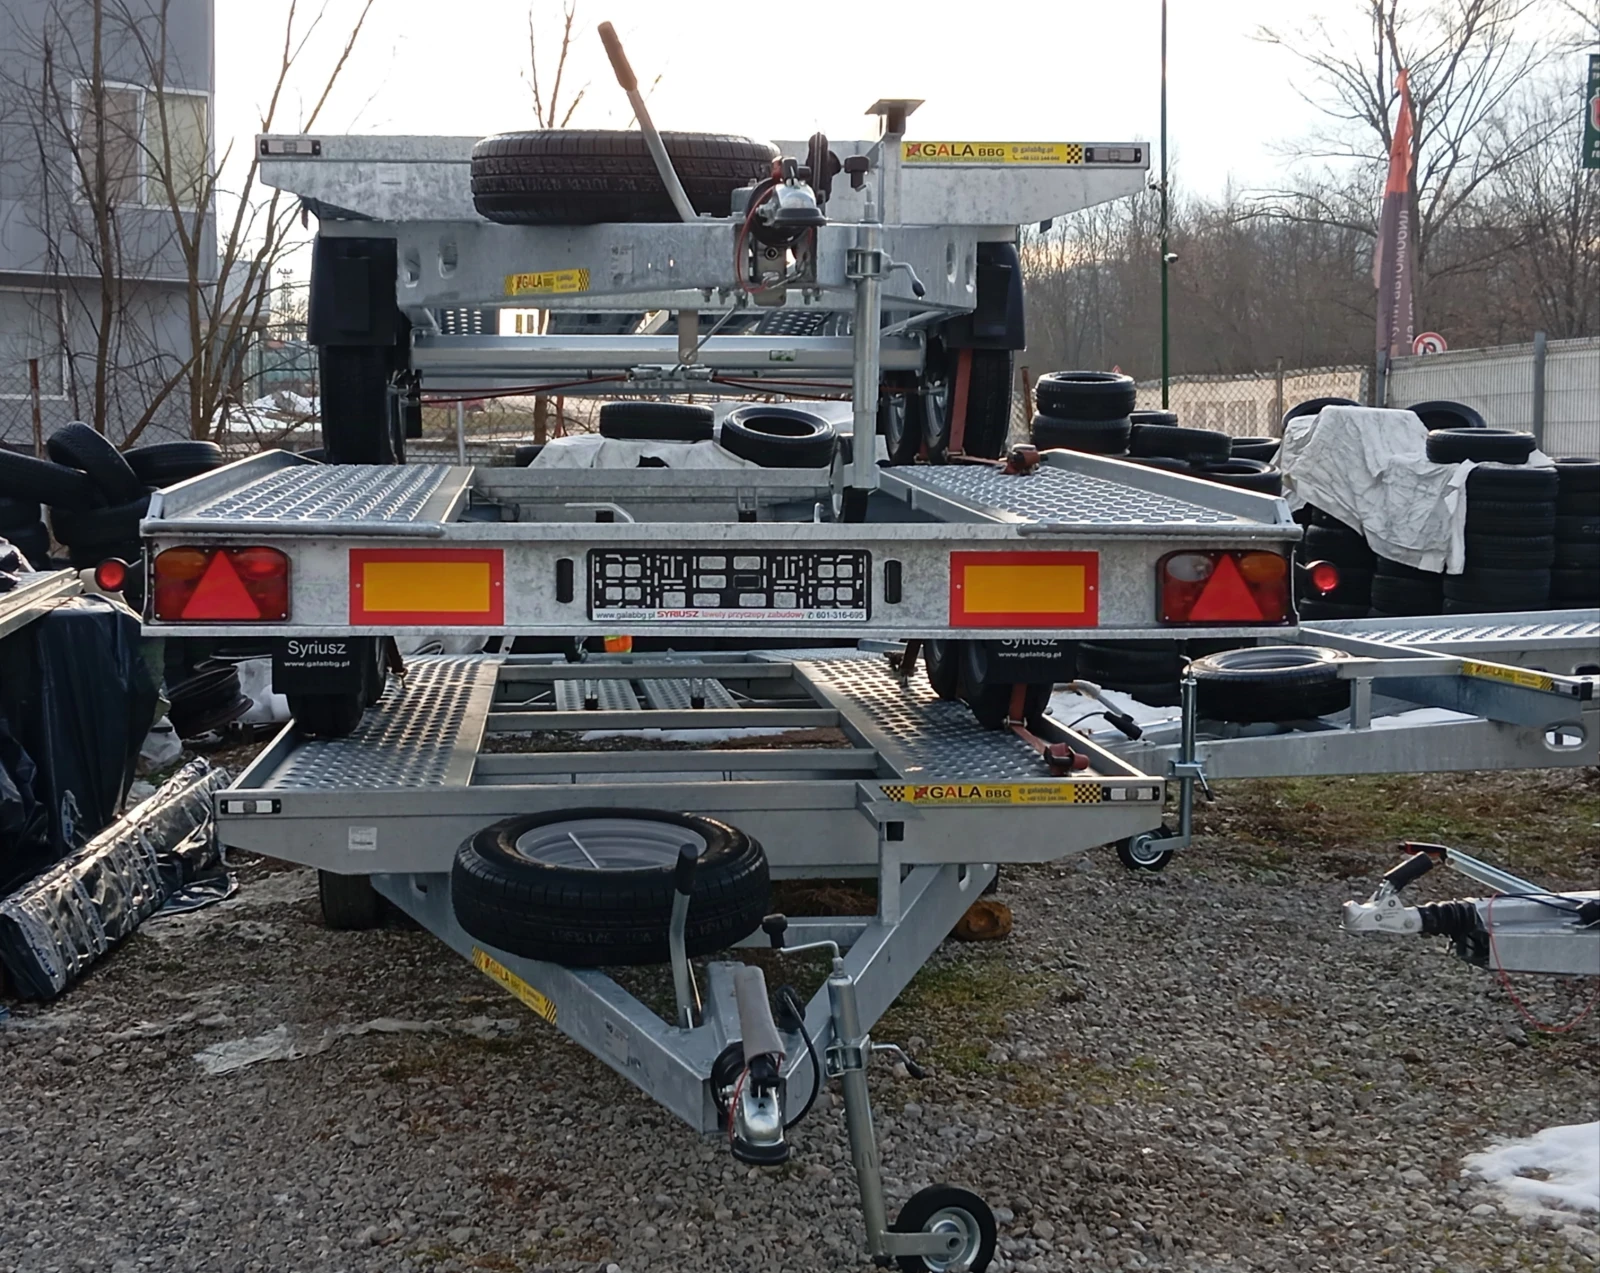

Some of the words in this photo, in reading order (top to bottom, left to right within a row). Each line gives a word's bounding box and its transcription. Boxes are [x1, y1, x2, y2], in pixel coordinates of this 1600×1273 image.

[922, 143, 975, 157] GALA
[978, 147, 1005, 157] BBG
[596, 611, 656, 620] www.galabbg.pl
[657, 610, 699, 618] SYRIUSZ
[767, 610, 805, 619] zabudowy
[816, 611, 864, 619] 601-316-695
[288, 640, 347, 658] Syriusz
[998, 651, 1062, 659] www.galabbg.pl
[284, 660, 351, 668] www.galabbg.pl
[930, 786, 982, 798] GALA
[985, 790, 1012, 798] BBG
